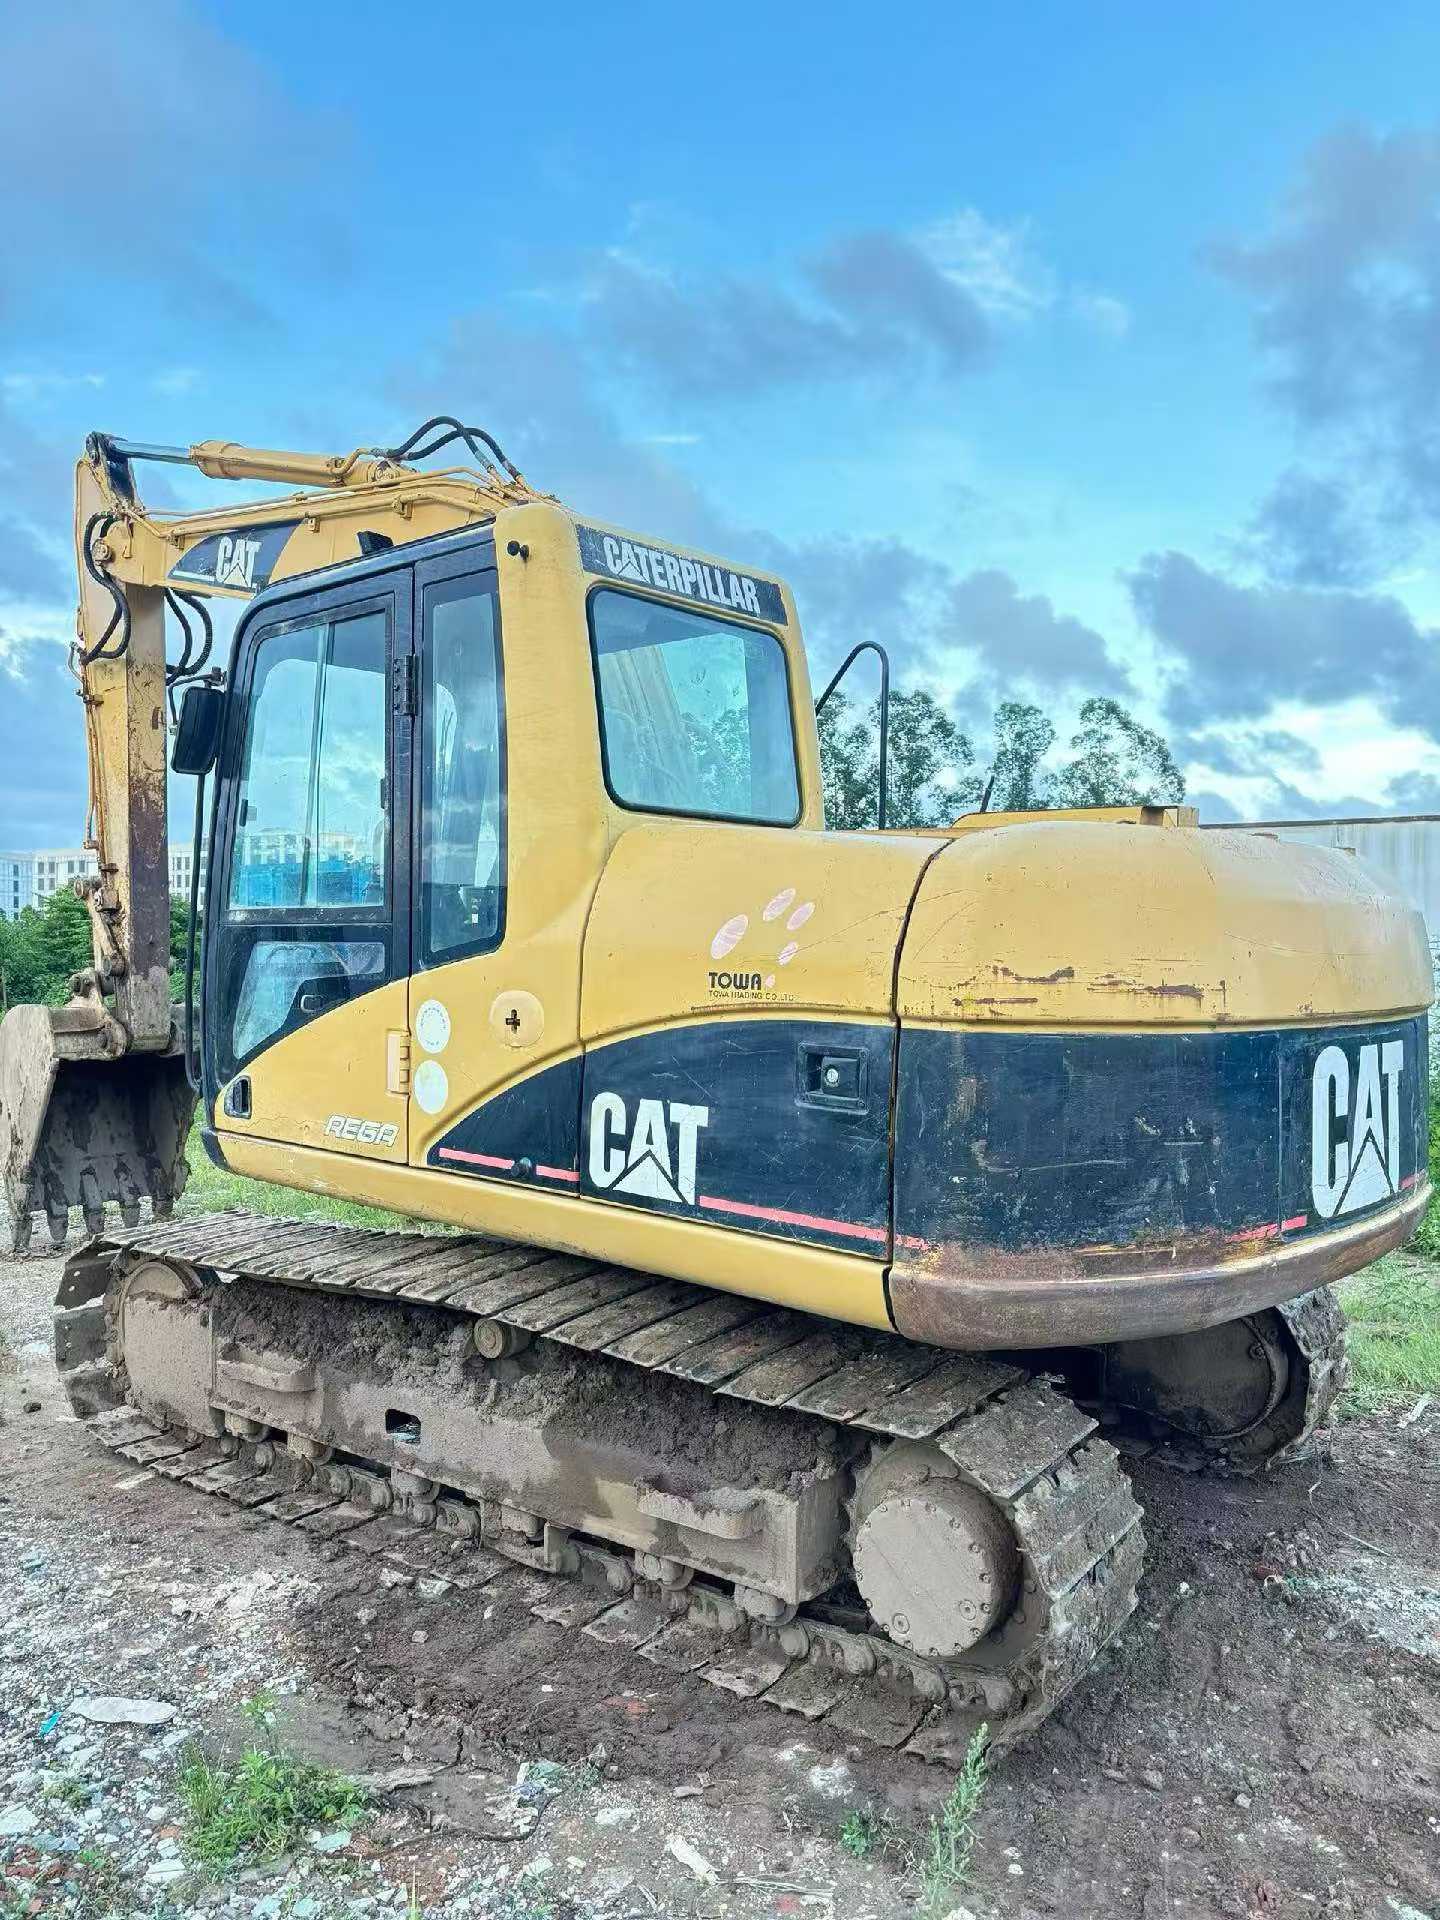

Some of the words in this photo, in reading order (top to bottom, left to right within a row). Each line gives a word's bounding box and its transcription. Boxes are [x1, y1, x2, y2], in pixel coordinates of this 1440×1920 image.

[215, 536, 262, 588] CAT
[603, 536, 761, 616] CATERPILLAR
[708, 972, 762, 990] TOWA
[589, 1091, 709, 1206] CAT
[1311, 1039, 1404, 1218] CAT
